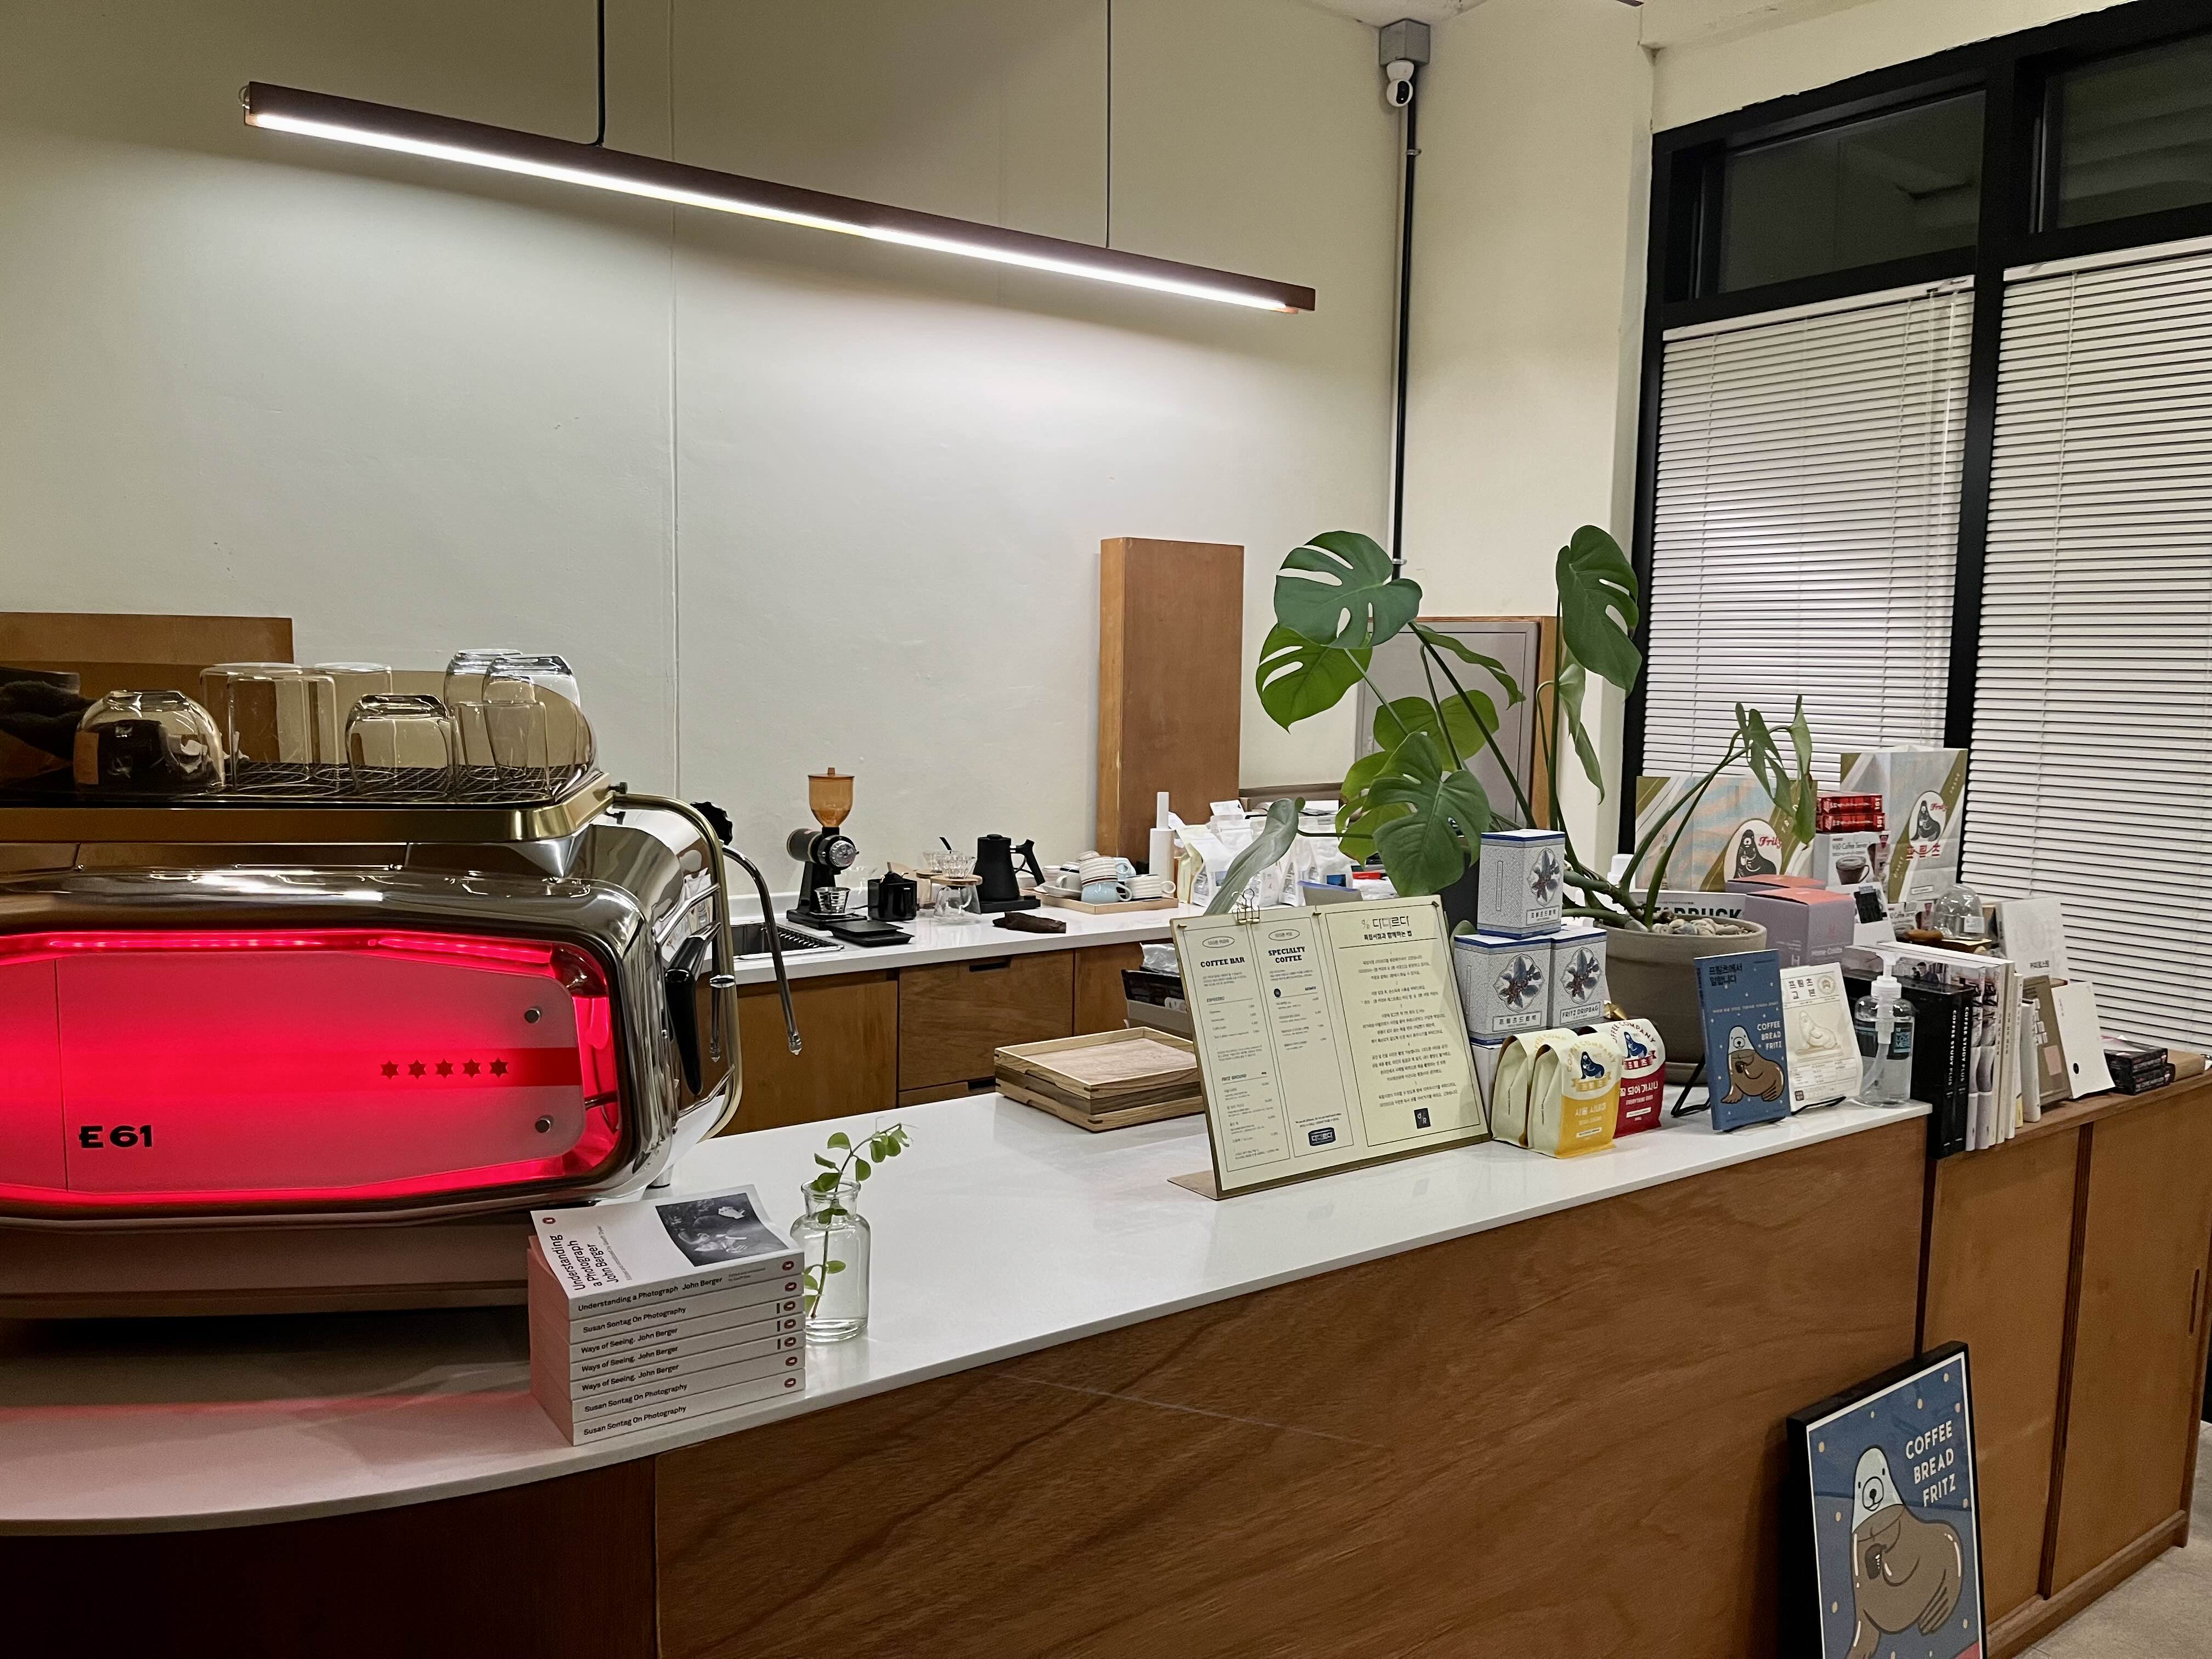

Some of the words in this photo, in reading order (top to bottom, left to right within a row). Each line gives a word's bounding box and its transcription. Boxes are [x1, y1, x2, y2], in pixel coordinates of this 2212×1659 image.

[1200, 958, 1228, 968] COFFEE
[1268, 946, 1306, 956] SPECIALTY
[1275, 955, 1302, 963] COFFEE
[1577, 1006, 1599, 1015] DRIPBAG
[1619, 1022, 1656, 1043] COMPANY
[1757, 1020, 1781, 1031] COFFEE
[1761, 1031, 1781, 1041] BREAD
[1765, 1041, 1782, 1050] FRITZ
[550, 1234, 586, 1290] Understanding
[567, 1240, 599, 1282] Photograph
[586, 1244, 608, 1267] Berger
[602, 1267, 619, 1283] John
[578, 1295, 631, 1312] Understanding
[638, 1286, 679, 1300] Photograph
[682, 1282, 699, 1291] John
[699, 1277, 723, 1288] Berger
[583, 1324, 605, 1333] Susan
[606, 1318, 631, 1328] Sontag
[643, 1307, 686, 1321] Photography
[581, 1344, 600, 1353] Ways
[656, 1328, 678, 1338] Berger
[582, 1363, 601, 1372] Ways
[656, 1346, 679, 1356] Berger
[582, 1381, 601, 1391] Ways
[656, 1364, 679, 1374] Berger
[585, 1403, 607, 1412] Susan
[608, 1396, 633, 1407] Sontag
[645, 1384, 687, 1398] Photography
[584, 1426, 606, 1435] Susan
[607, 1419, 631, 1430] Sontag
[644, 1406, 686, 1420] Photography
[1906, 1420, 1953, 1459] COFFEE
[1914, 1448, 1954, 1485] BREAD
[1923, 1473, 1956, 1508] FRITZ
